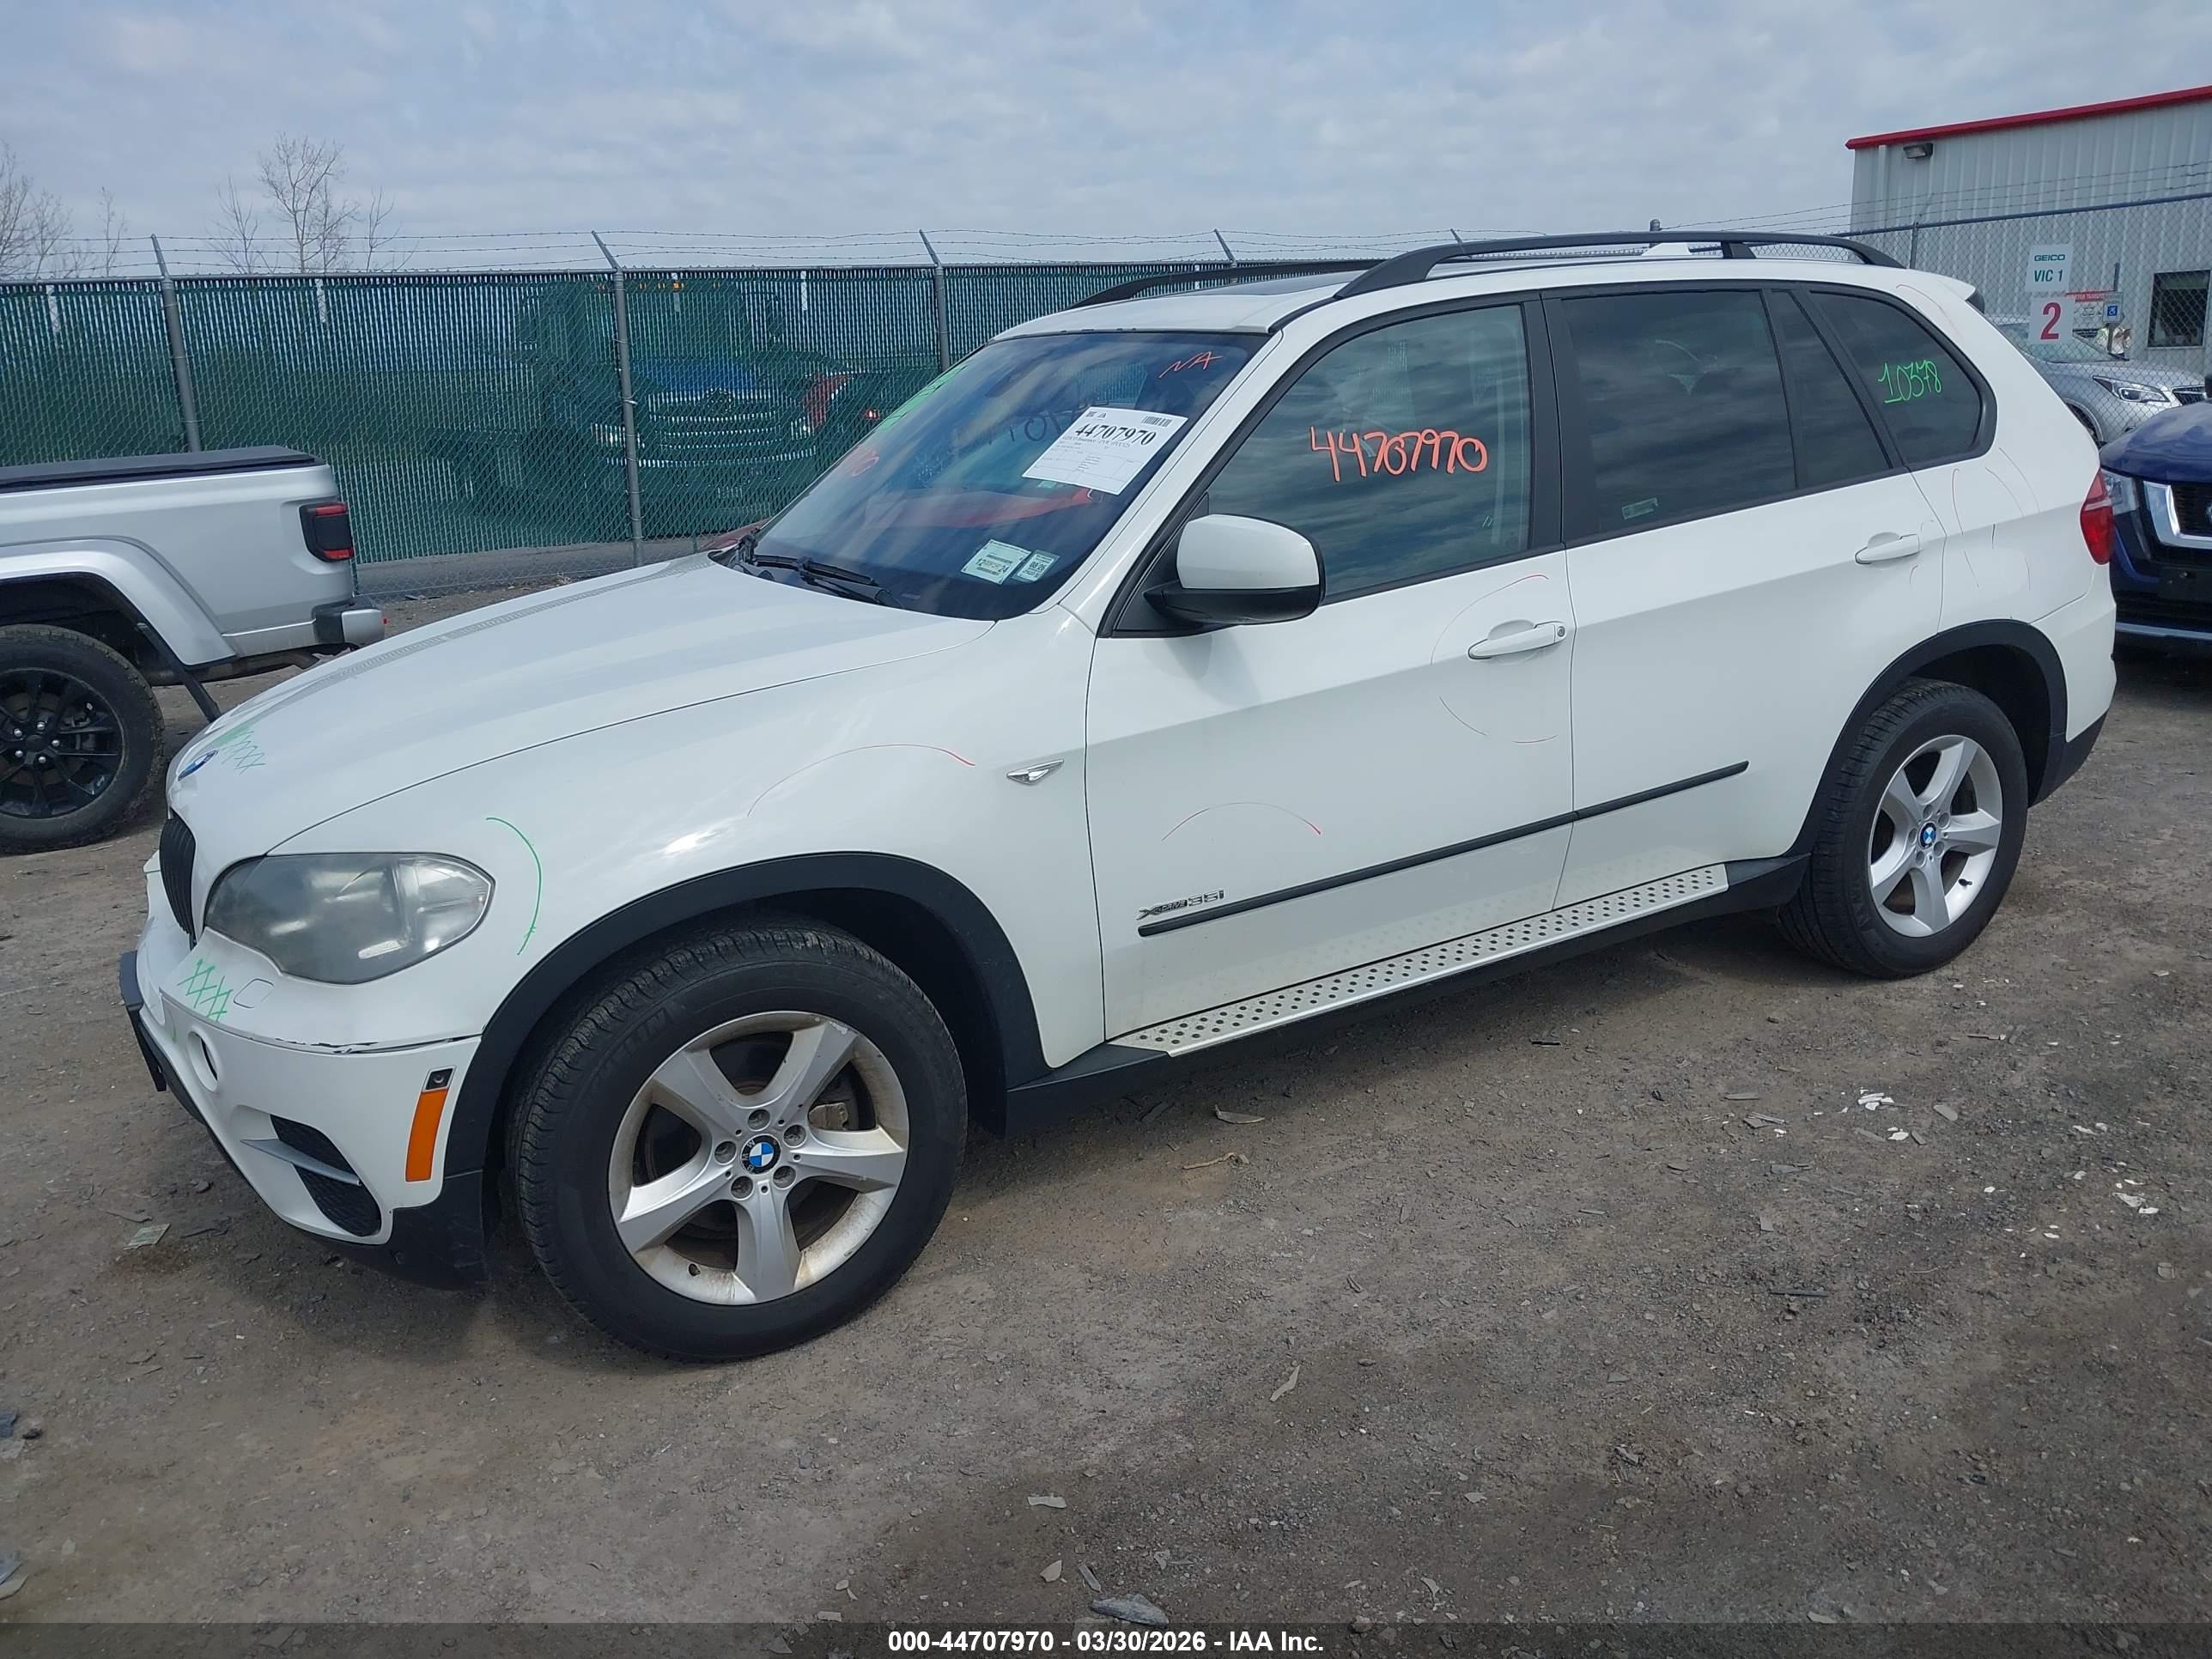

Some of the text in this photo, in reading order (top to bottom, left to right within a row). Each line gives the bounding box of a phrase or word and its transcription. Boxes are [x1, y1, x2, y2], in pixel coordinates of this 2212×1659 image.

[2033, 253, 2066, 262] GEICO
[2033, 269, 2063, 283] VIC 1
[2040, 301, 2062, 340] 2
[1075, 423, 1157, 447] 44707970
[1310, 426, 1488, 483] 44707970
